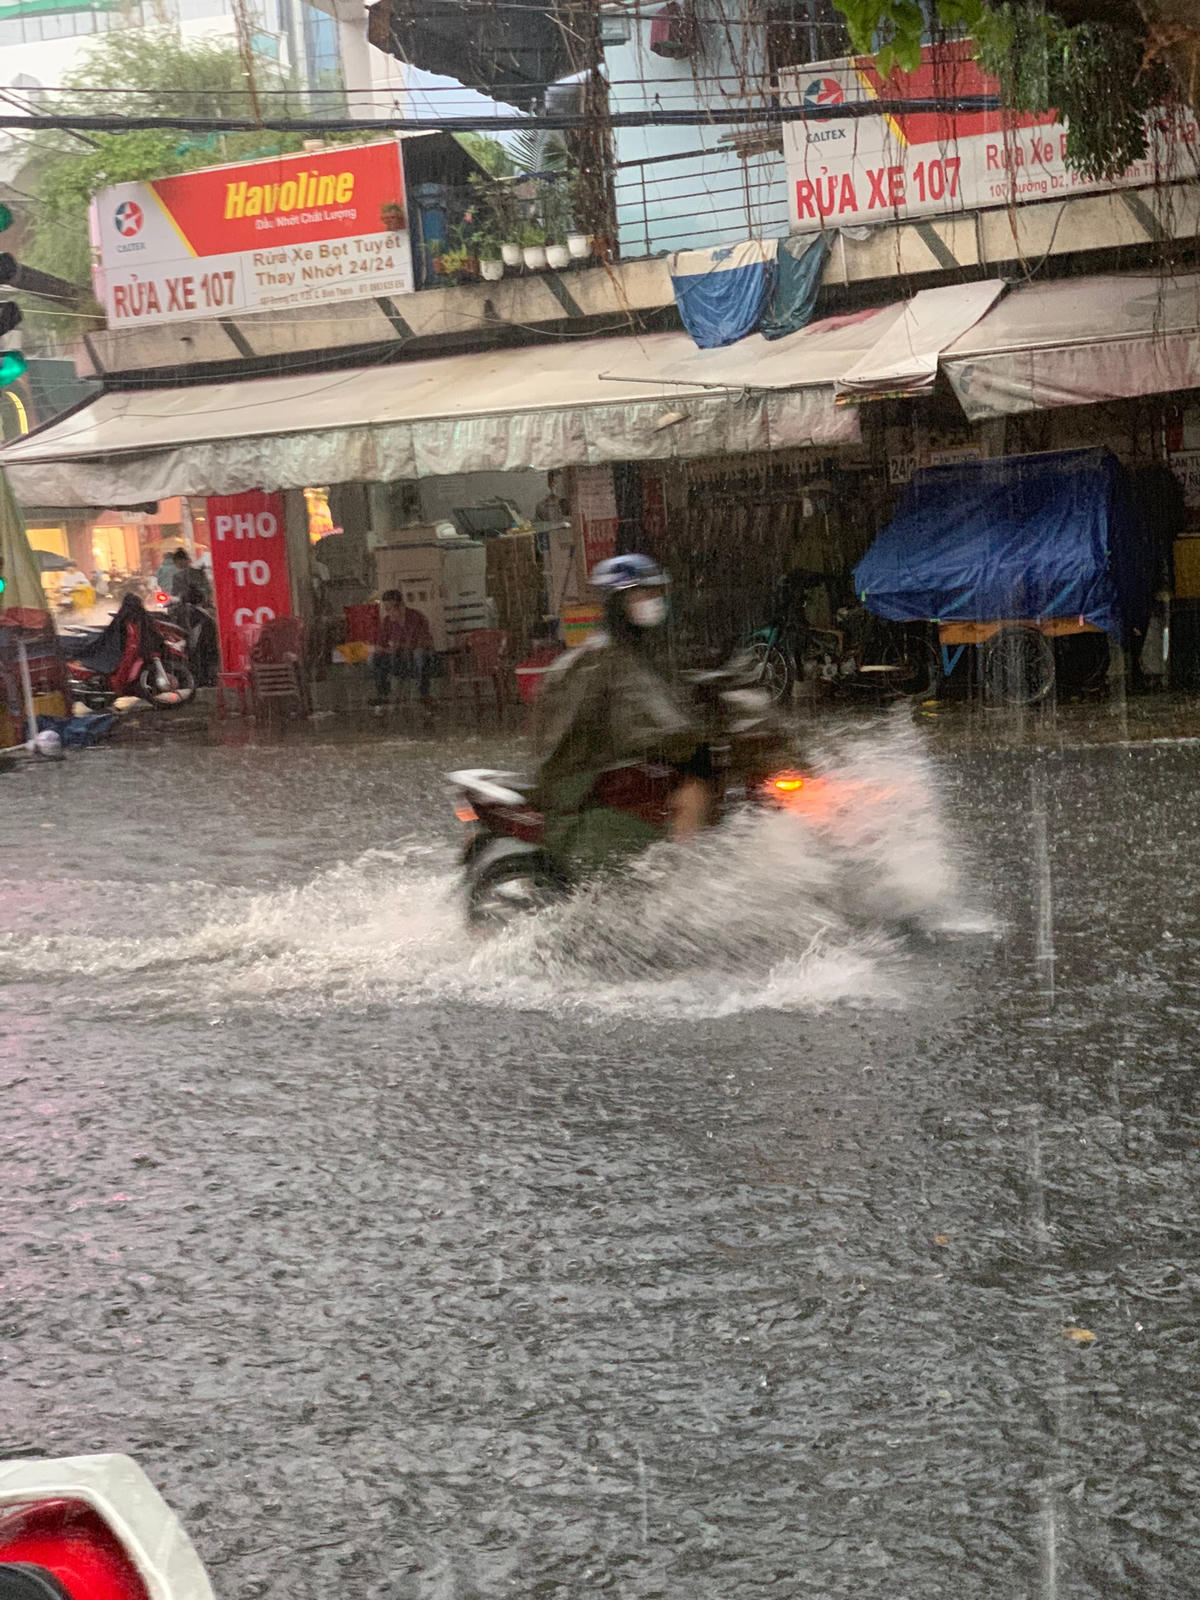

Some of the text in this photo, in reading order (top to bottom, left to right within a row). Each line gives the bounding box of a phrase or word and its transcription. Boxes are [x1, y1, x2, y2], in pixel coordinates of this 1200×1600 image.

[806, 128, 847, 144] CALTEX
[224, 170, 355, 219] Havoline
[796, 156, 961, 220] RỬA XE 107
[292, 248, 313, 262] Xe
[319, 243, 348, 260] Bọt
[354, 234, 401, 254] Tuyết
[255, 271, 295, 286] Thay
[349, 255, 394, 275] 24/24
[113, 273, 162, 318] RỬA
[165, 276, 197, 312] XE
[201, 270, 236, 307] 107
[215, 511, 277, 541] PHO
[228, 559, 271, 587] TO
